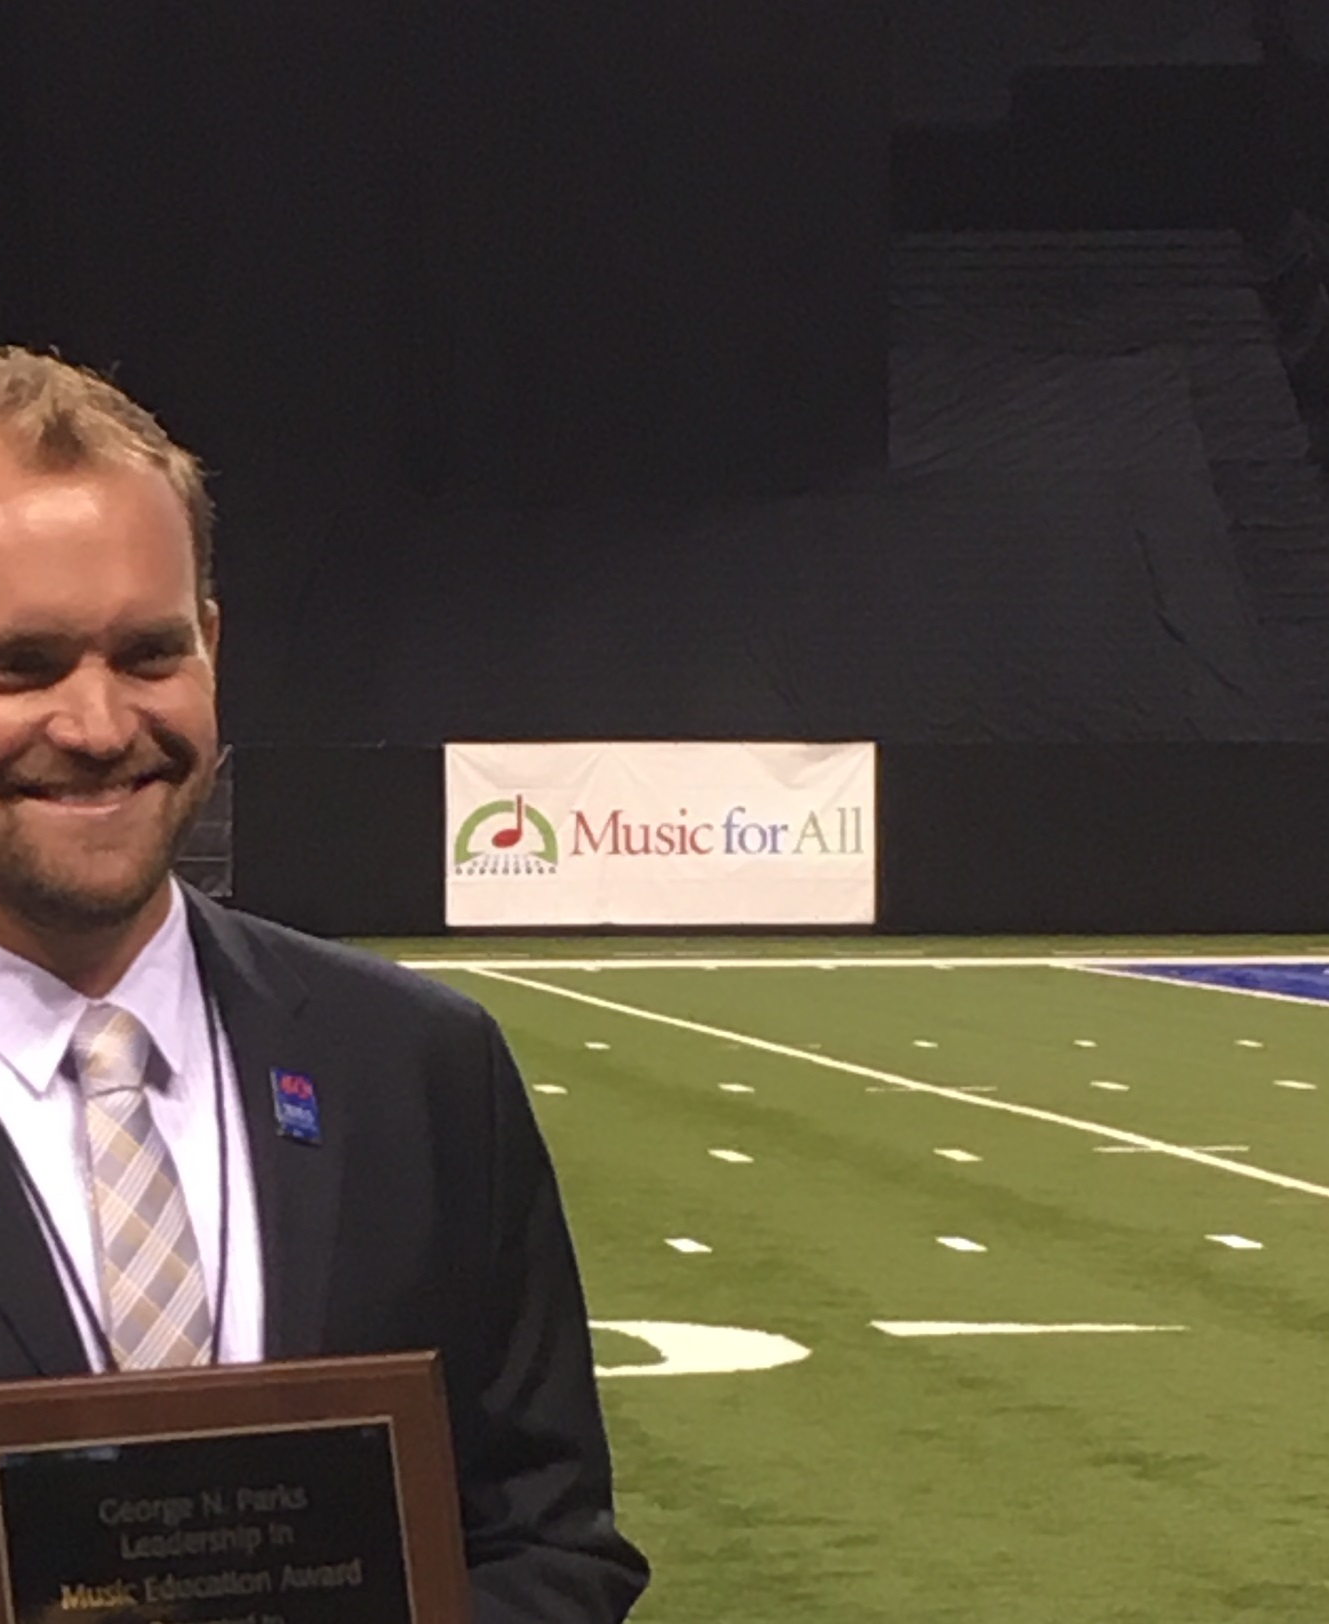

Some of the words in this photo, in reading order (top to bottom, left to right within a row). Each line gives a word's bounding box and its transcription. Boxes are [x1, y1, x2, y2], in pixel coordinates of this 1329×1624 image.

[571, 808, 713, 856] Music
[722, 806, 788, 855] for
[793, 807, 863, 855] All
[98, 1495, 194, 1527] George
[200, 1489, 224, 1517] N.
[236, 1484, 309, 1513] Parks
[120, 1525, 263, 1560] Leadership
[269, 1522, 295, 1546] in
[60, 1578, 139, 1611] Music
[144, 1570, 272, 1603] Education
[282, 1558, 364, 1592] Award
